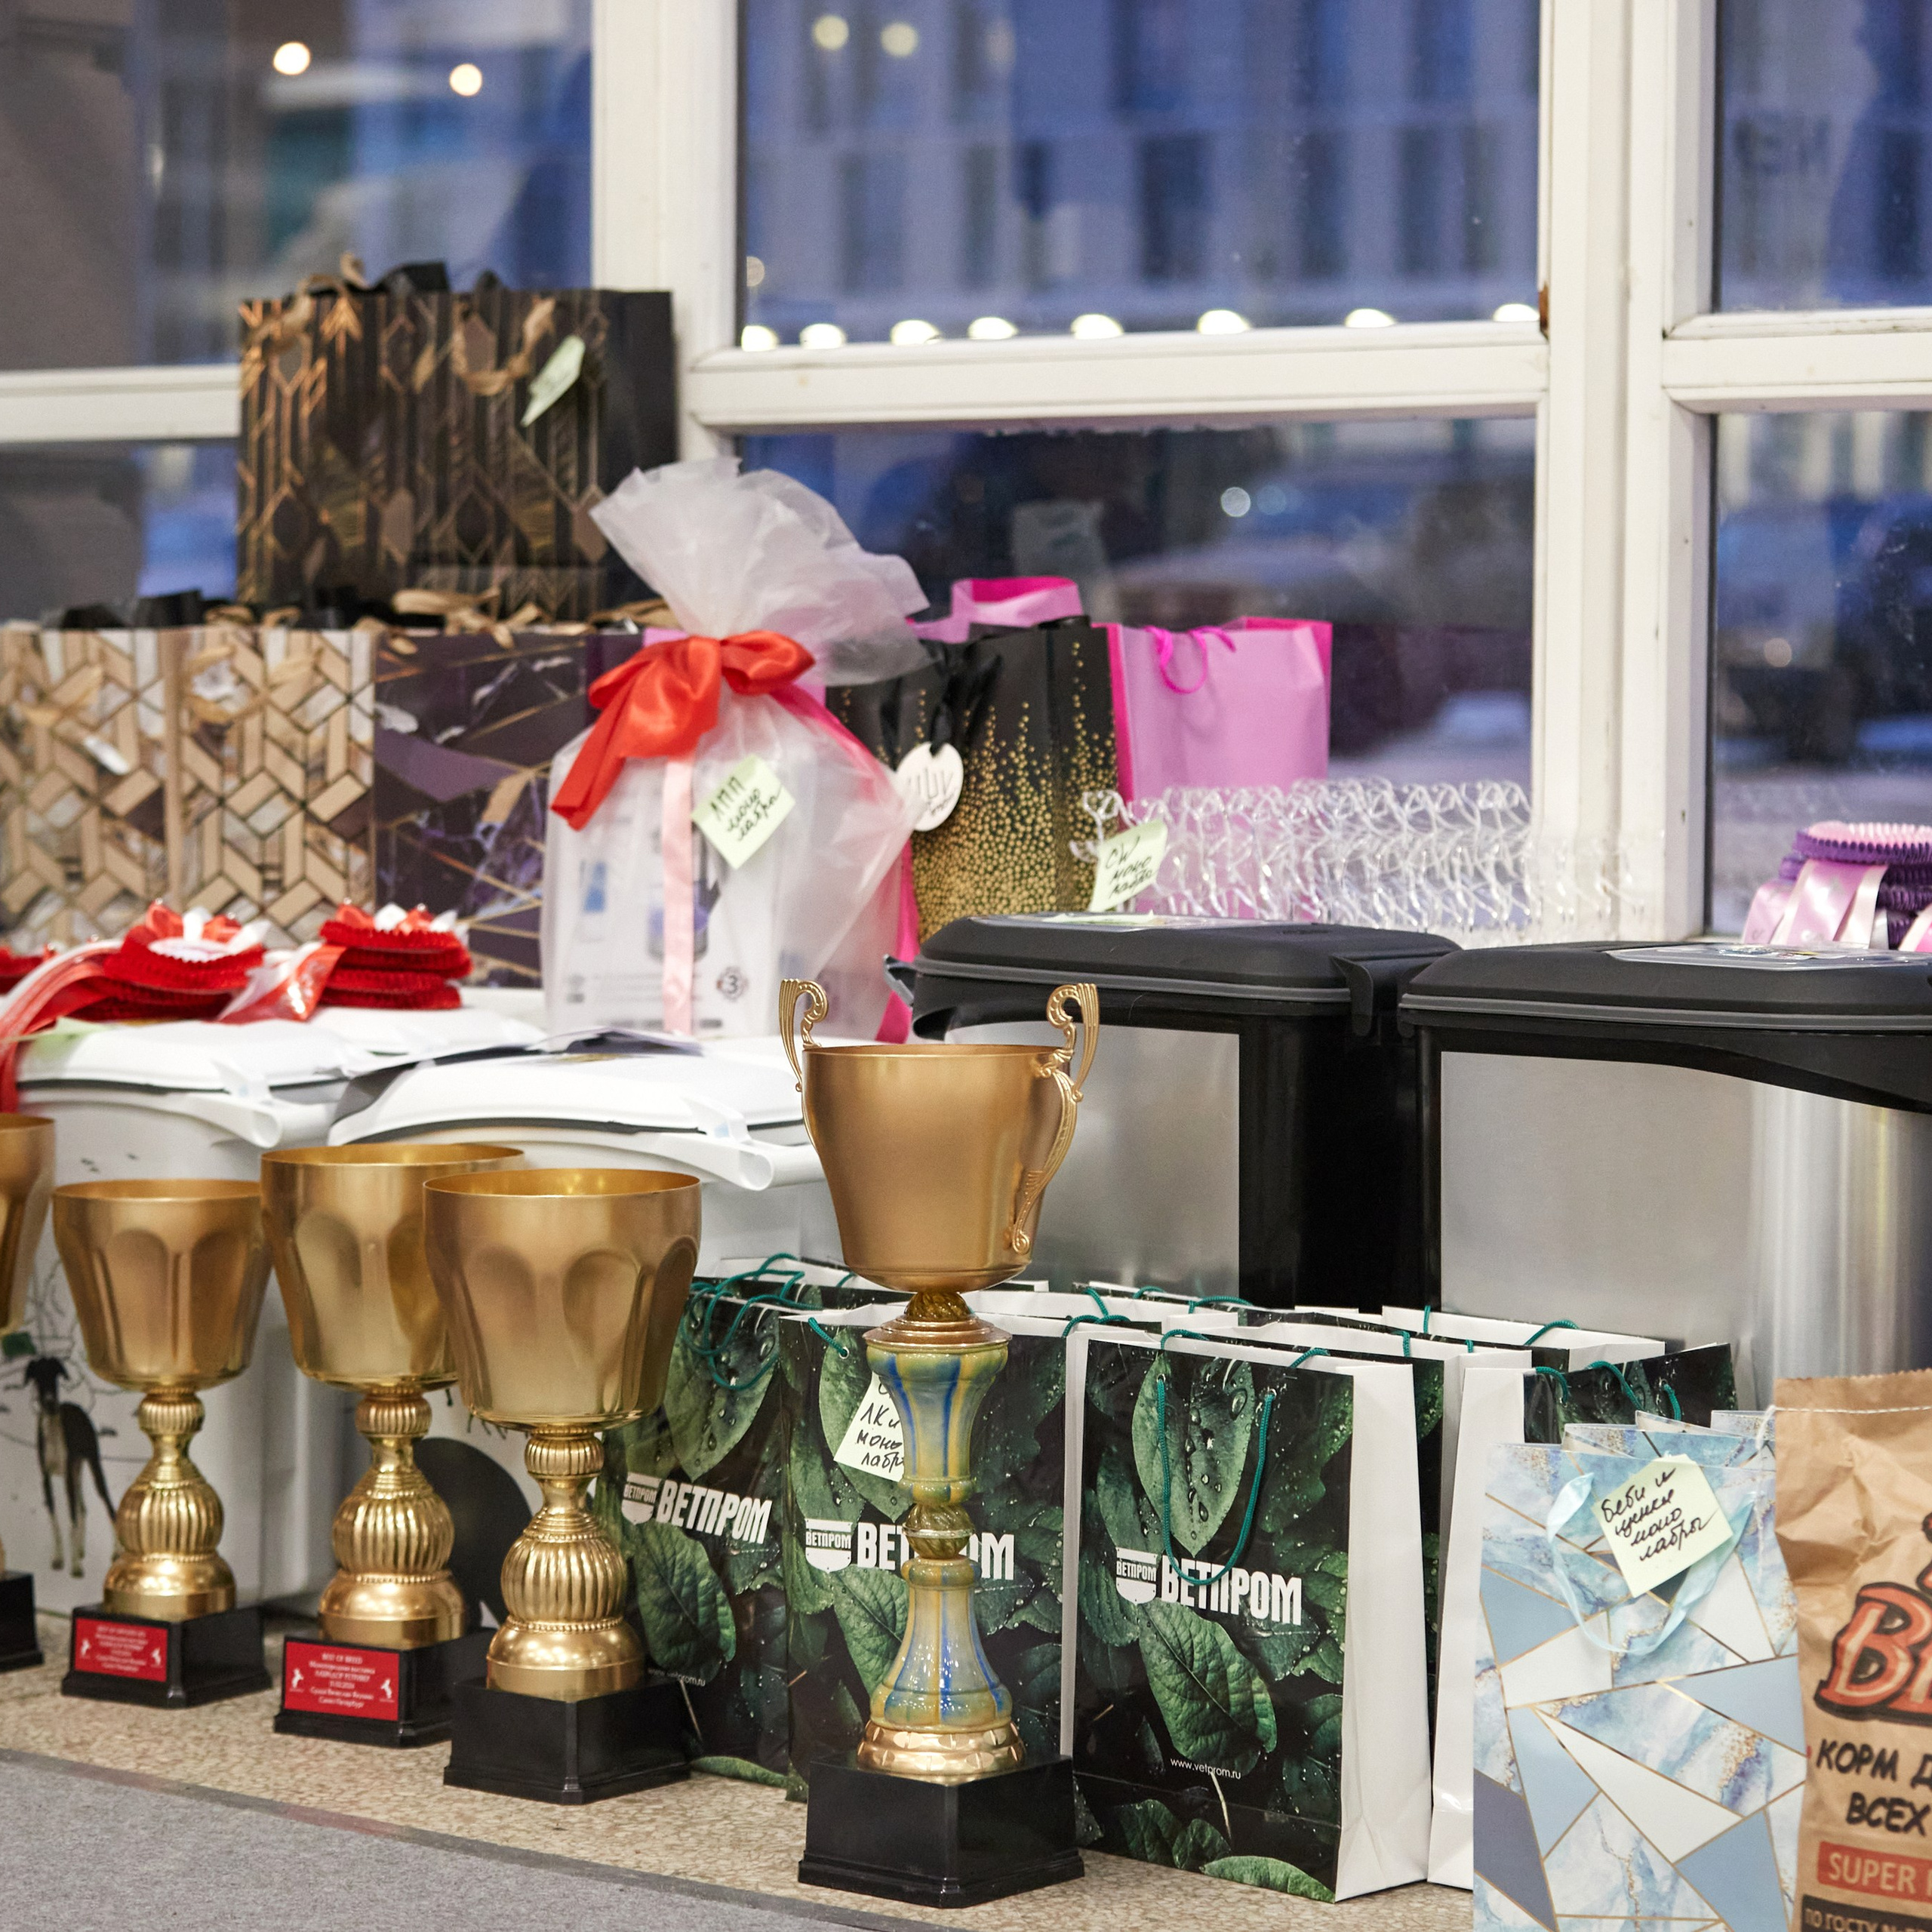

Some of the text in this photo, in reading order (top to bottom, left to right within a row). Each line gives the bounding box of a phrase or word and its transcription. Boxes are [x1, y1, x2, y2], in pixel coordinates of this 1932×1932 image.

[861, 1451, 904, 1473] лабр
[656, 1479, 773, 1544] ВЕТПРОМ
[805, 1530, 852, 1549] ВЕТПРОМ
[1115, 1561, 1157, 1582] ВЕТПРОМ
[1161, 1555, 1303, 1626] ВЕТПРОМ
[1171, 1758, 1241, 1780] www.vetprom.ru
[1816, 1738, 1900, 1782] КОРМ
[1845, 1792, 1931, 1837] ВСЕХ
[1828, 1852, 1917, 1894] SUPER
